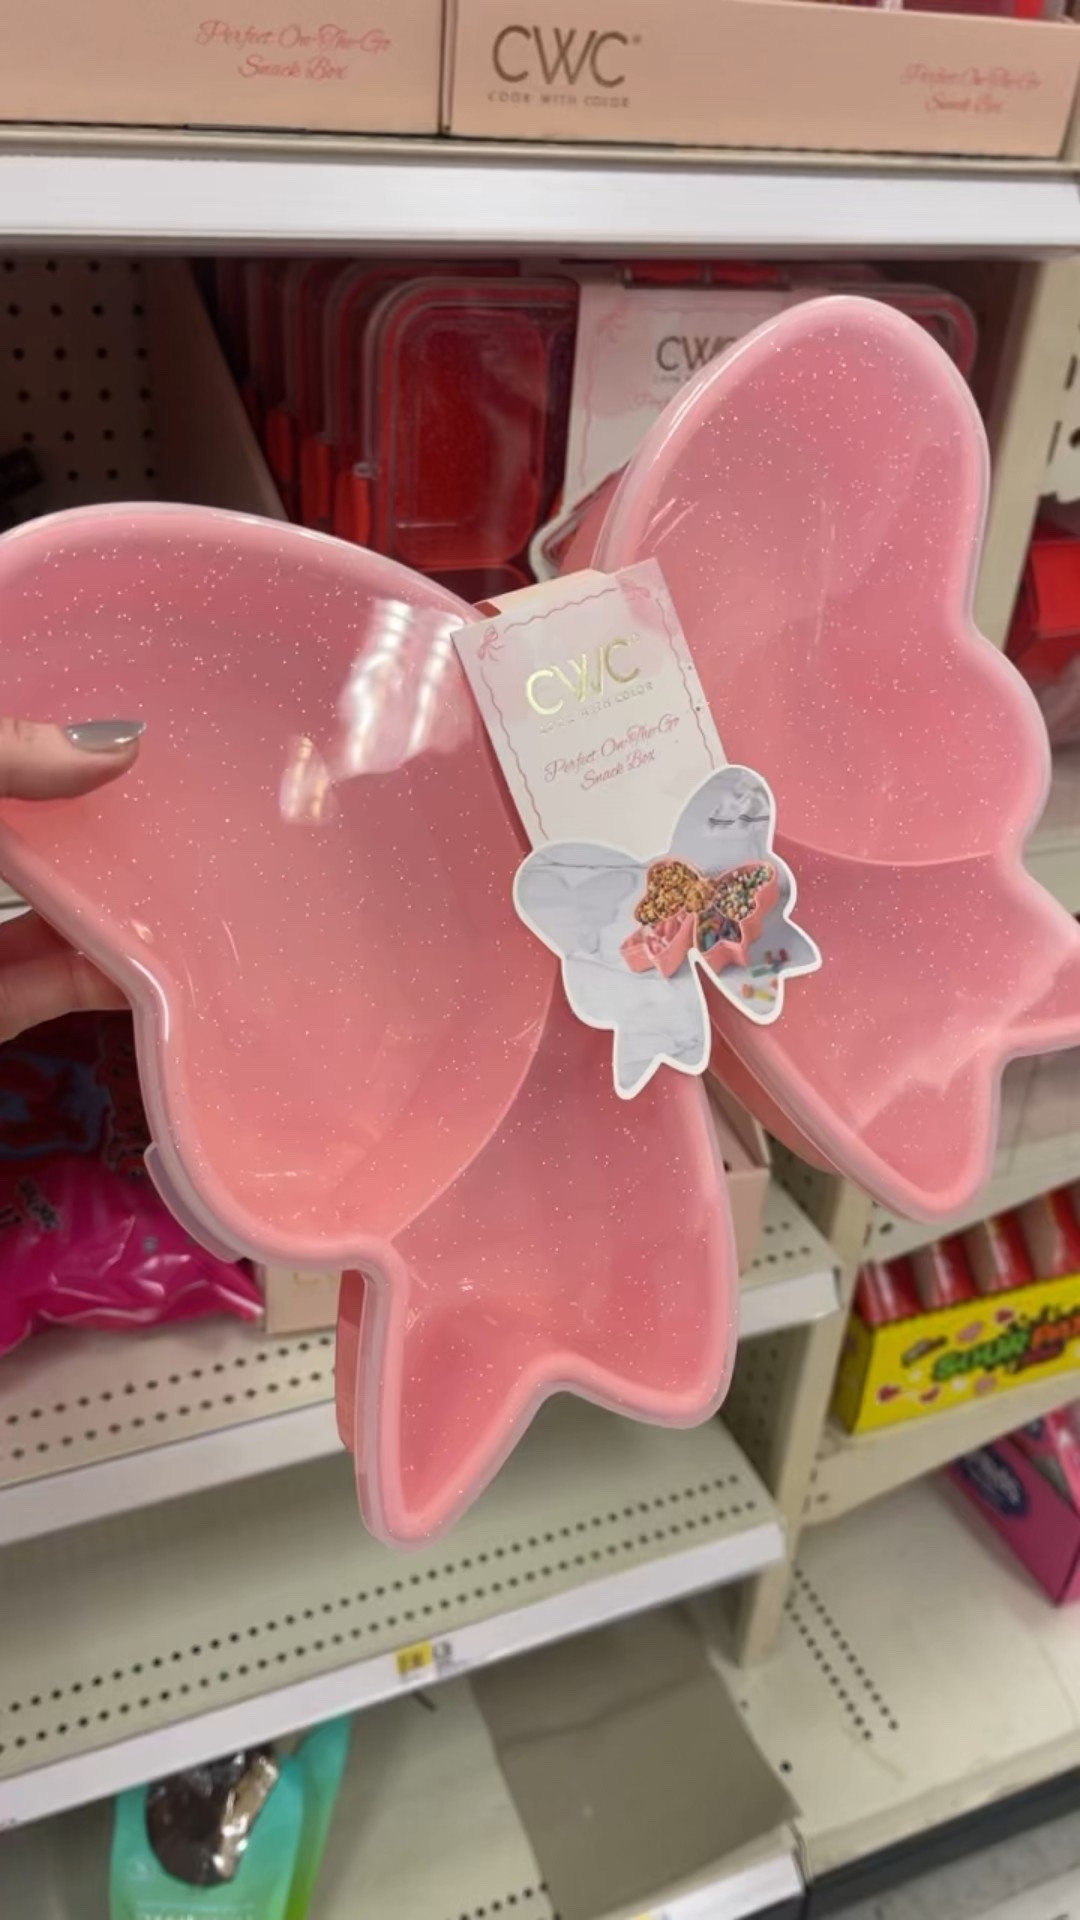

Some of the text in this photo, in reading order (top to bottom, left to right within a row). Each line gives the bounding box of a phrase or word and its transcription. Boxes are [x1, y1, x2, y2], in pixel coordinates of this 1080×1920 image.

[238, 54, 348, 79] Snack Box
[540, 94, 577, 107] WITH
[584, 96, 630, 108] COLOR
[615, 681, 654, 703] COLOR
[543, 750, 596, 783] Perfect
[580, 749, 656, 790] Snack Box
